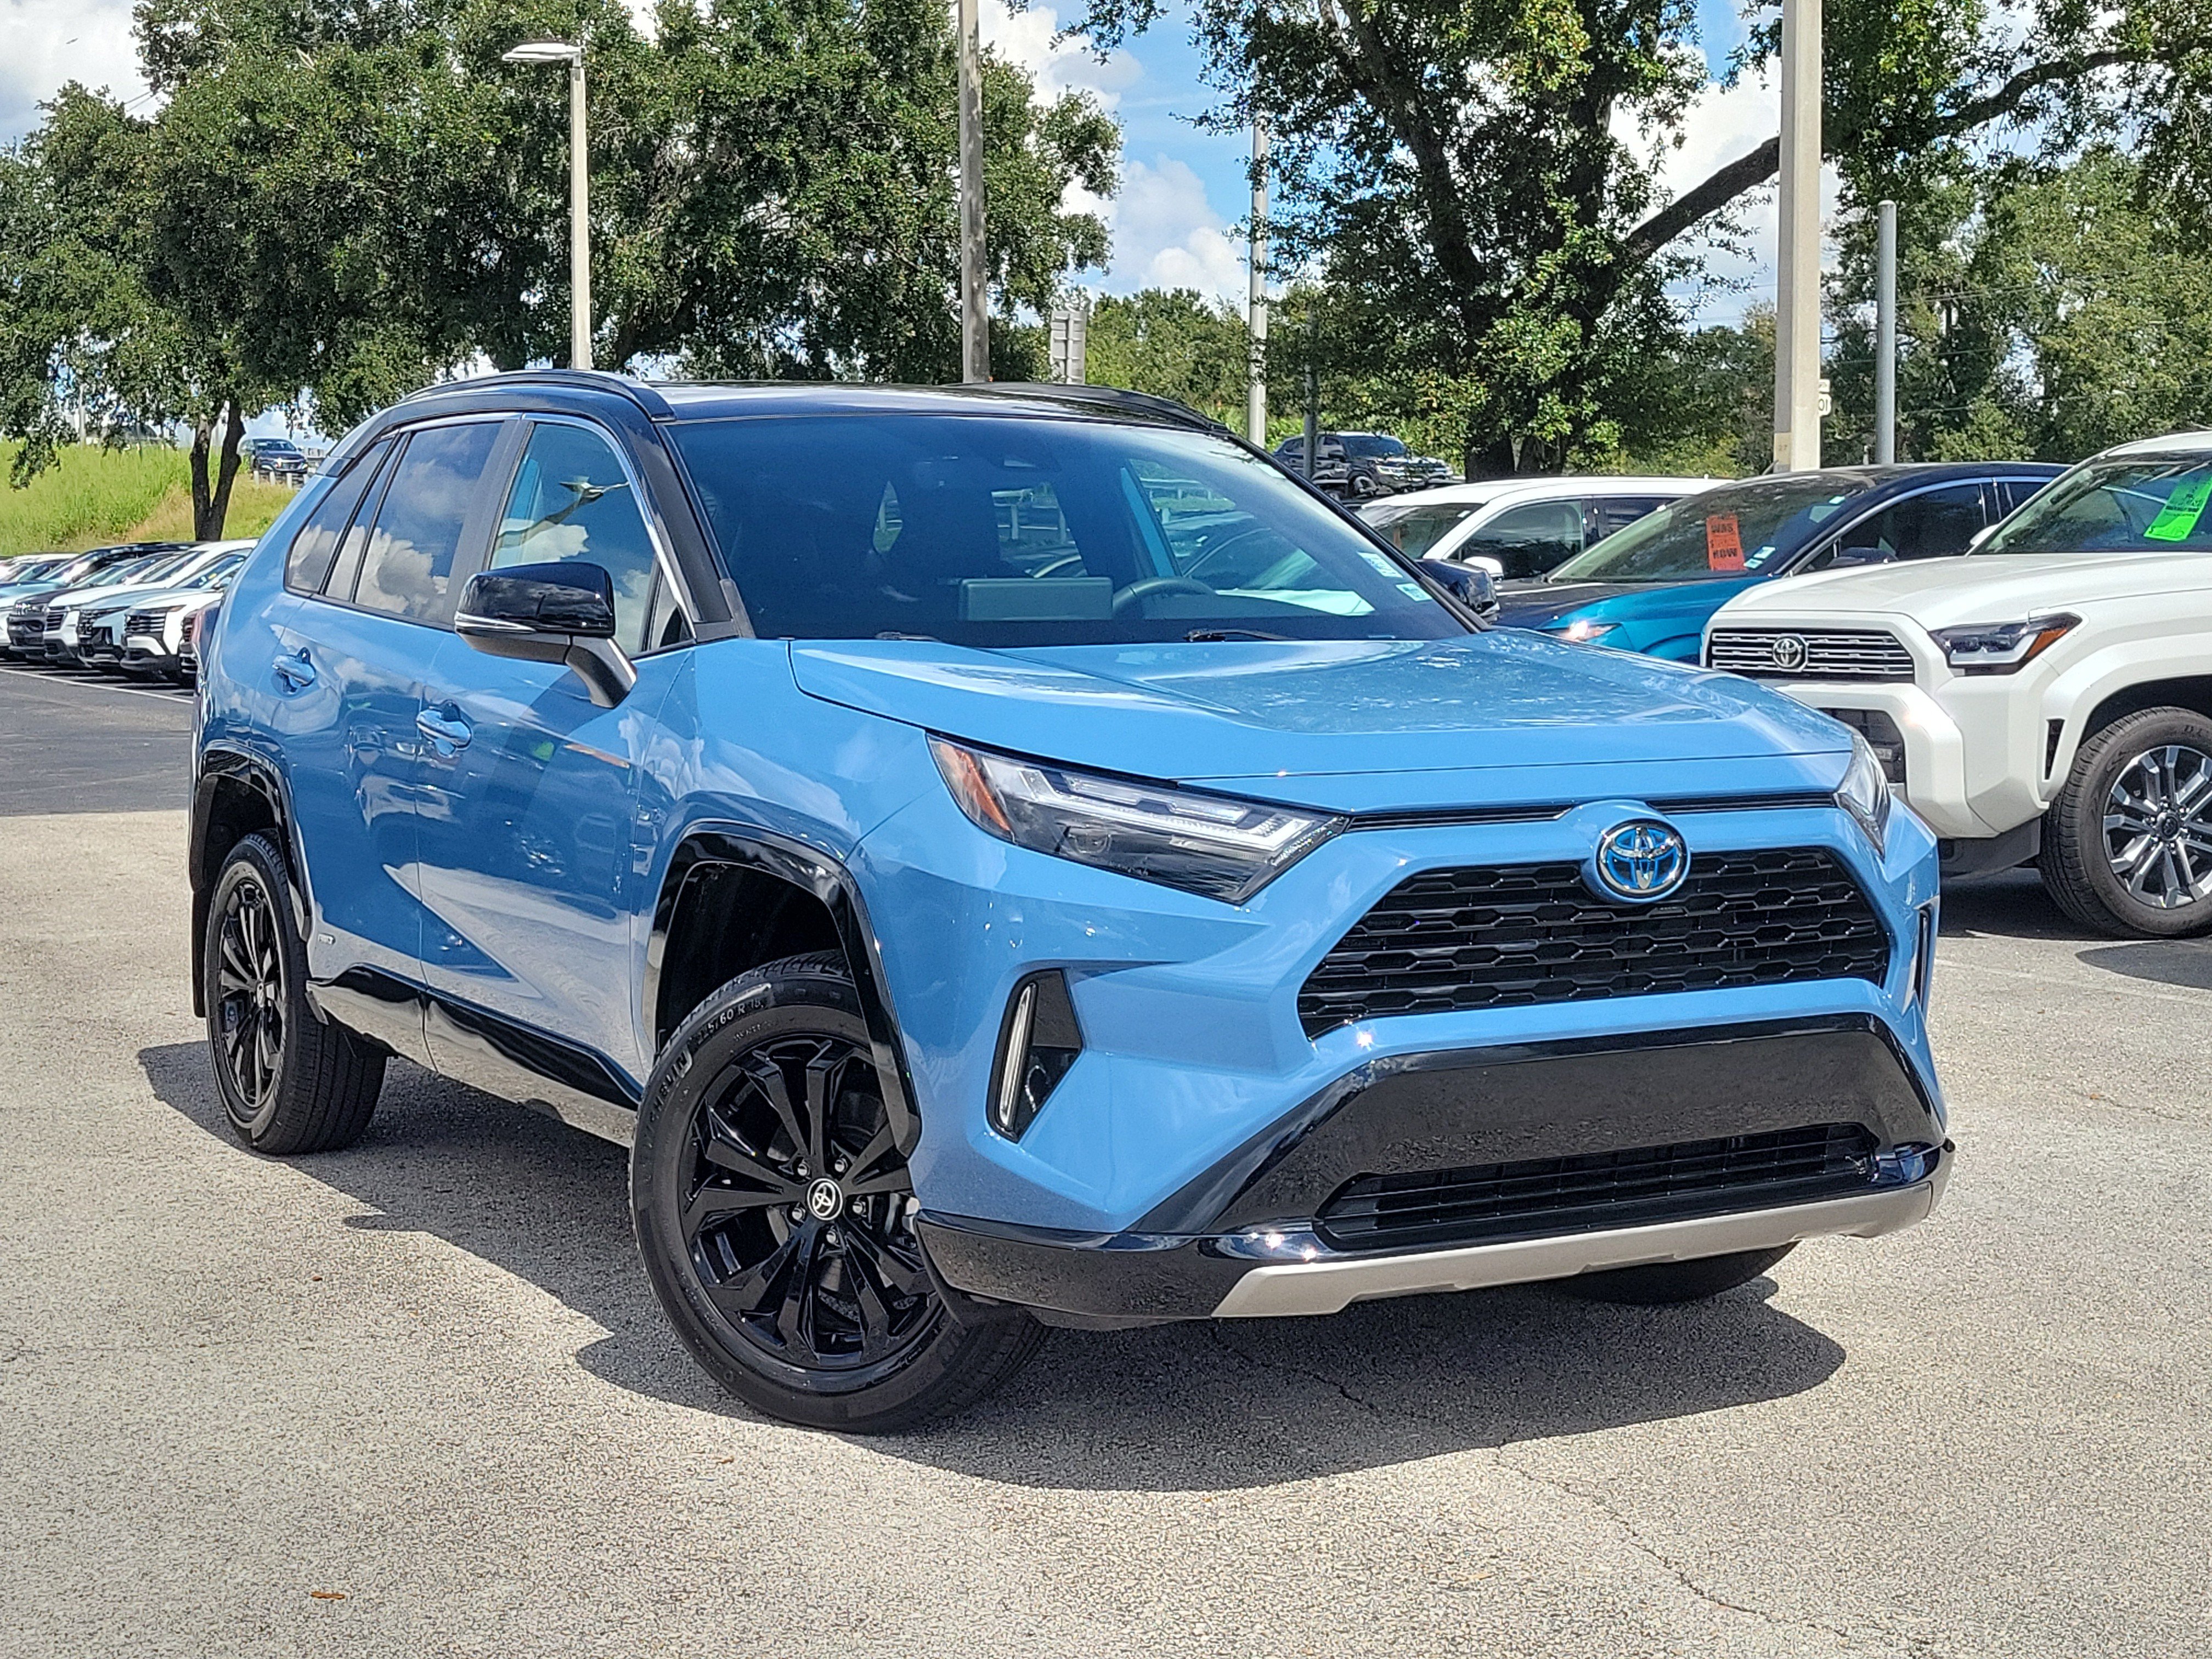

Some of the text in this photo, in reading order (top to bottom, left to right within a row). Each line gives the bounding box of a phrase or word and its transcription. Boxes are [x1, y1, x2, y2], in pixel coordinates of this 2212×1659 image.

[1818, 398, 1828, 412] 01
[1711, 523, 1733, 533] WAS
[1713, 548, 1737, 558] NOW
